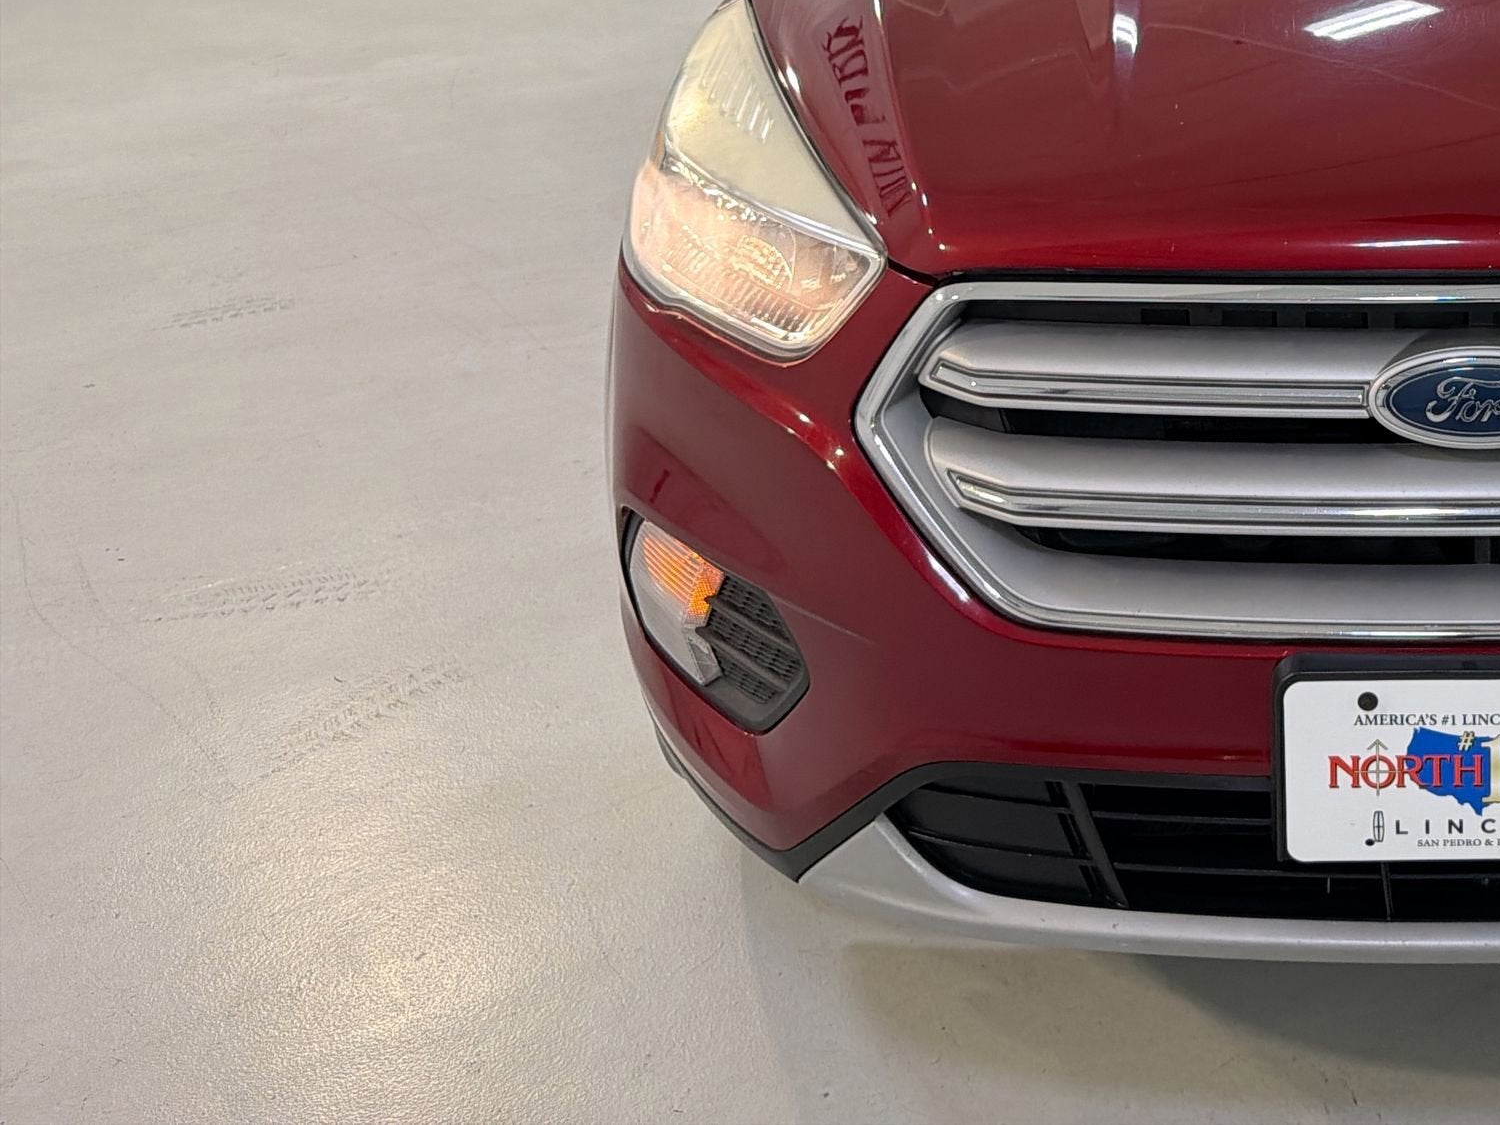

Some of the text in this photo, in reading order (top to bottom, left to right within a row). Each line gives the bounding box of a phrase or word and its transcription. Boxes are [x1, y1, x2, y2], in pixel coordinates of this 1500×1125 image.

[1354, 713, 1437, 726] AMERICA'S
[1441, 713, 1457, 726] #1
[1328, 753, 1483, 789] NORTH
[1417, 838, 1440, 847] SAN
[1443, 838, 1482, 847] PEDRO
[1484, 838, 1494, 847] &
